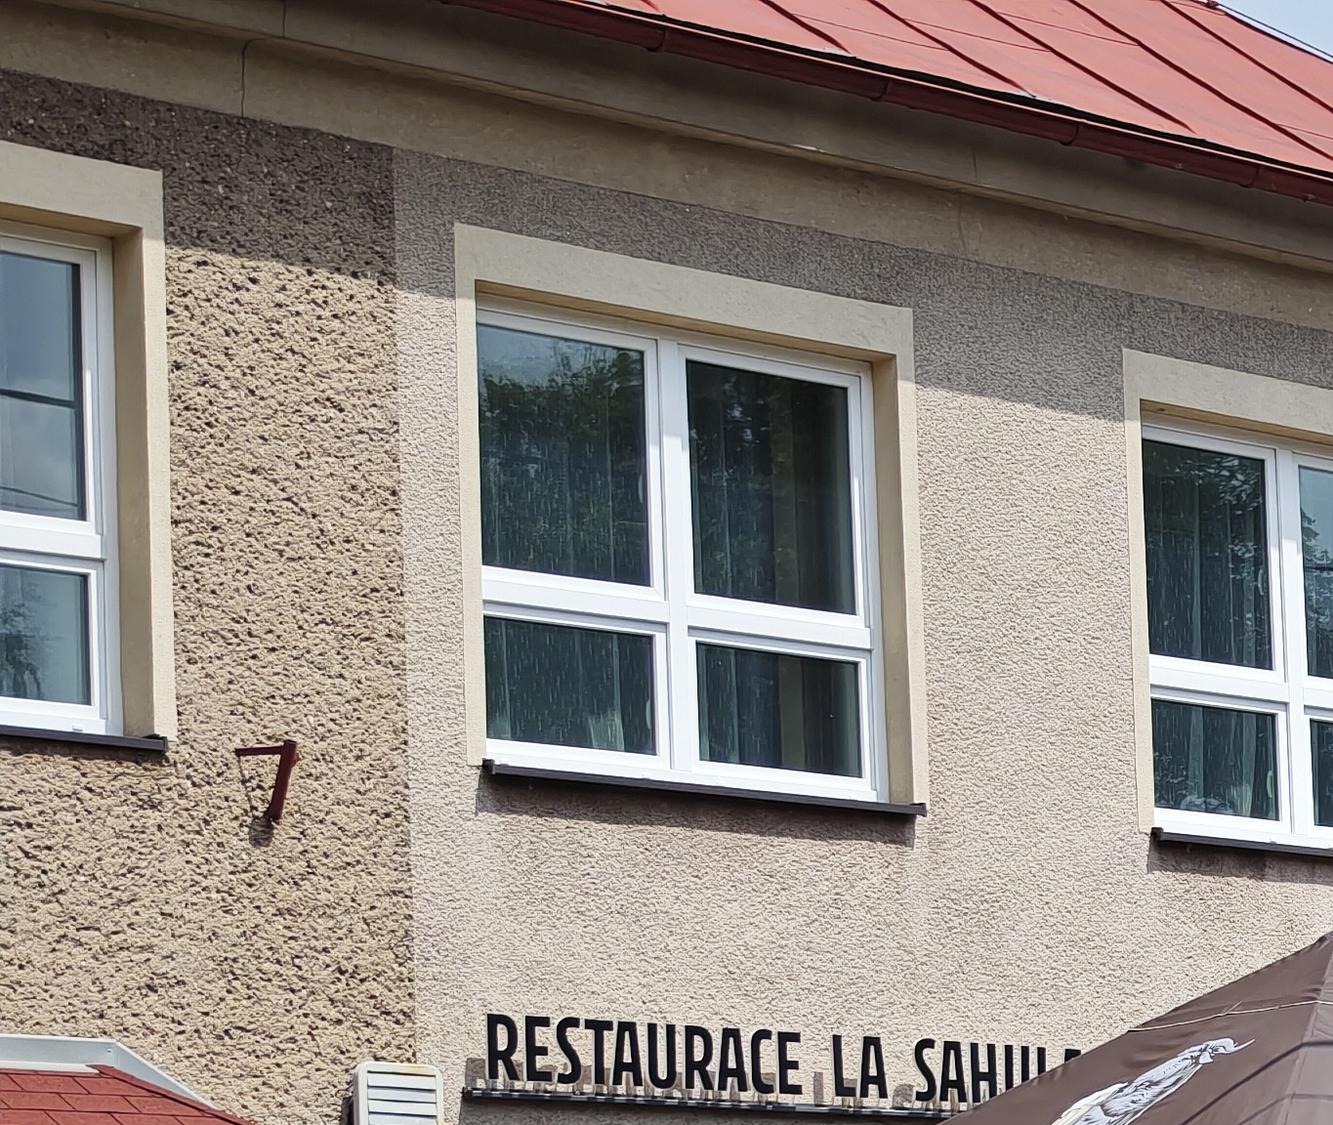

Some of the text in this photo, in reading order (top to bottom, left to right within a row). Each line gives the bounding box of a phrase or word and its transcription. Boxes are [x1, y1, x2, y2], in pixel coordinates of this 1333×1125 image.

[486, 1013, 1081, 1103] RESTAURACE LA SAHU
